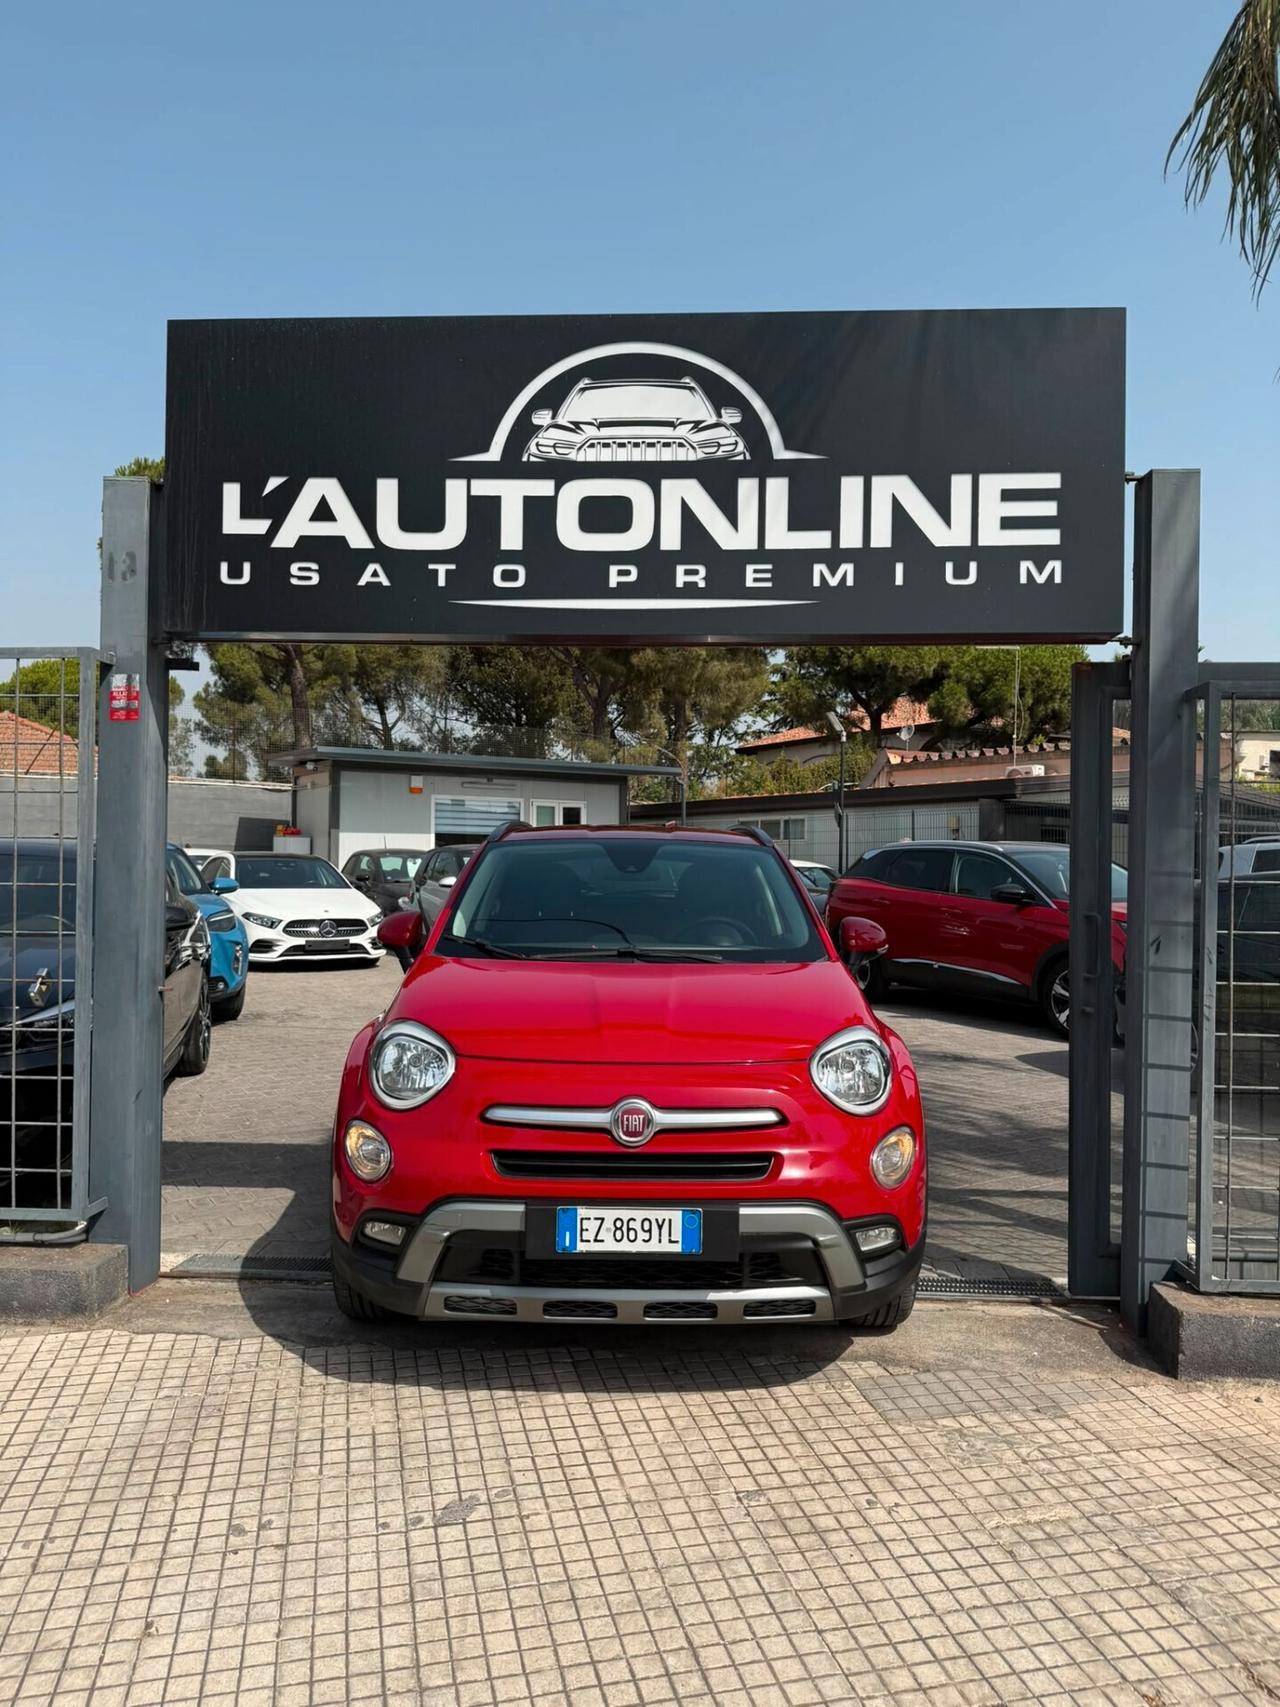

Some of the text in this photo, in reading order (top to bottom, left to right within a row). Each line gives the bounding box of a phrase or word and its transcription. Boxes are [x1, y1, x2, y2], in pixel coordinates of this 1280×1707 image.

[222, 473, 1061, 551] L'AUTONLINE
[220, 560, 1062, 588] USATO PREMIUM
[623, 1114, 645, 1132] FIAT
